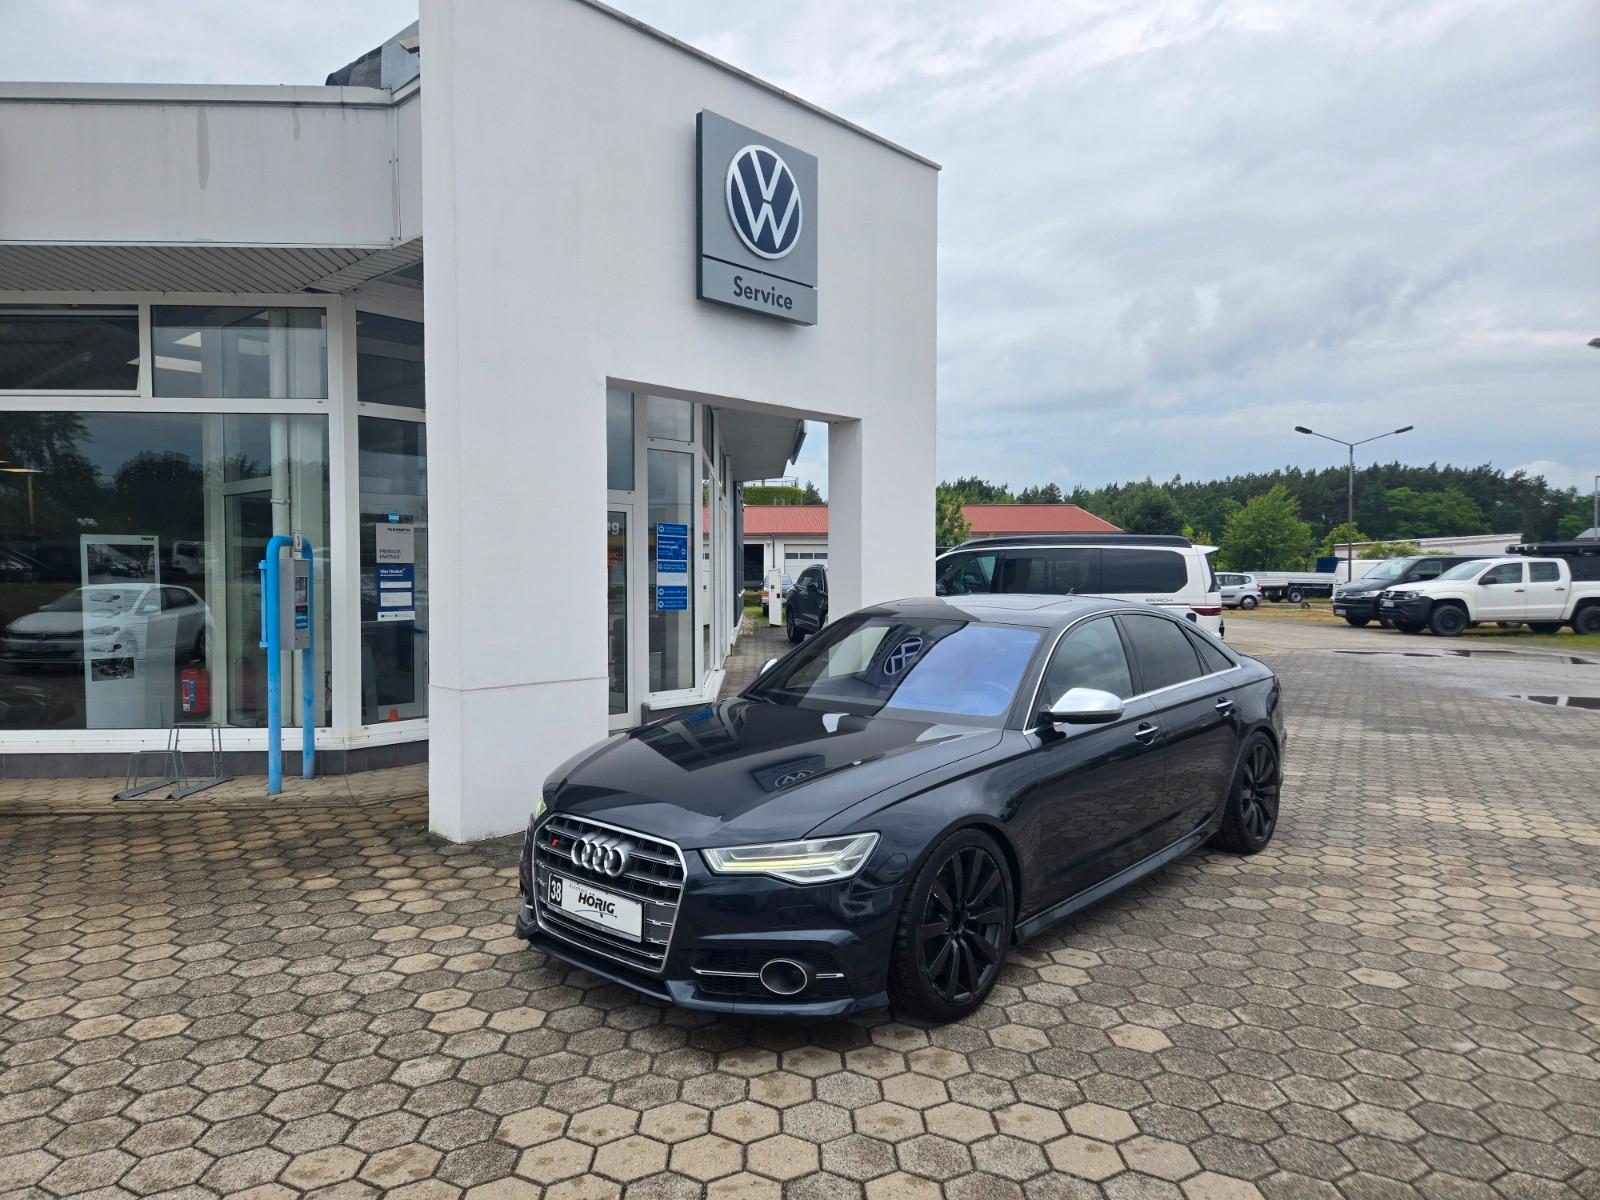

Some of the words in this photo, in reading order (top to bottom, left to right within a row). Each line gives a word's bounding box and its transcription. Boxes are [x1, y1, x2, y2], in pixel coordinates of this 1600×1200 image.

[733, 275, 793, 310] Service
[550, 880, 562, 902] 38
[578, 892, 616, 916] HÖRIG
